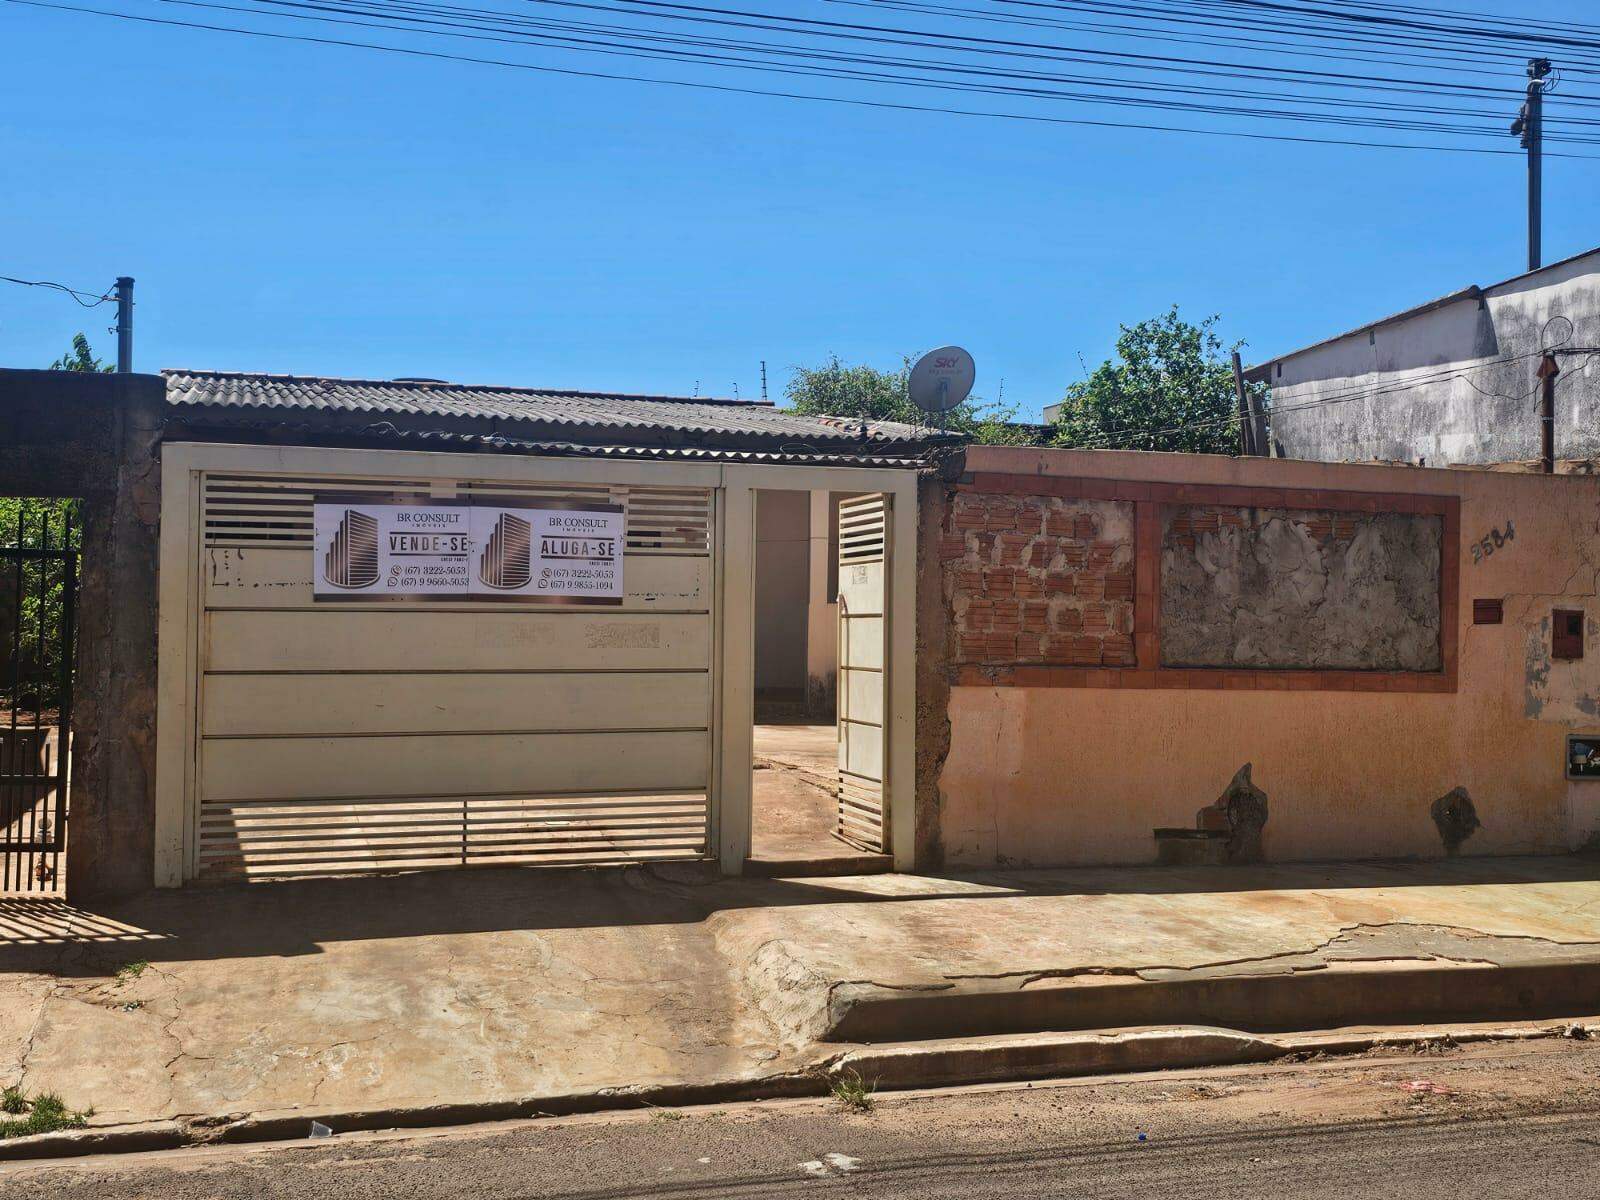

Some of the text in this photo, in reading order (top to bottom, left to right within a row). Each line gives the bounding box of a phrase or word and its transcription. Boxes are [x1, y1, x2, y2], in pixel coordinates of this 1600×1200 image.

[934, 357, 960, 368] SKY
[397, 513, 460, 523] BR CONSULT
[549, 517, 608, 528] BR CONSULT
[389, 536, 468, 551] VENDE-SE
[541, 540, 615, 556] ALUGA-SE
[405, 566, 466, 576] (67) 3222-5053
[553, 569, 614, 579] (67) 3222-5053
[401, 577, 417, 587] (67)
[419, 577, 425, 587] 9
[550, 581, 565, 590] (67)
[567, 581, 573, 590] 9
